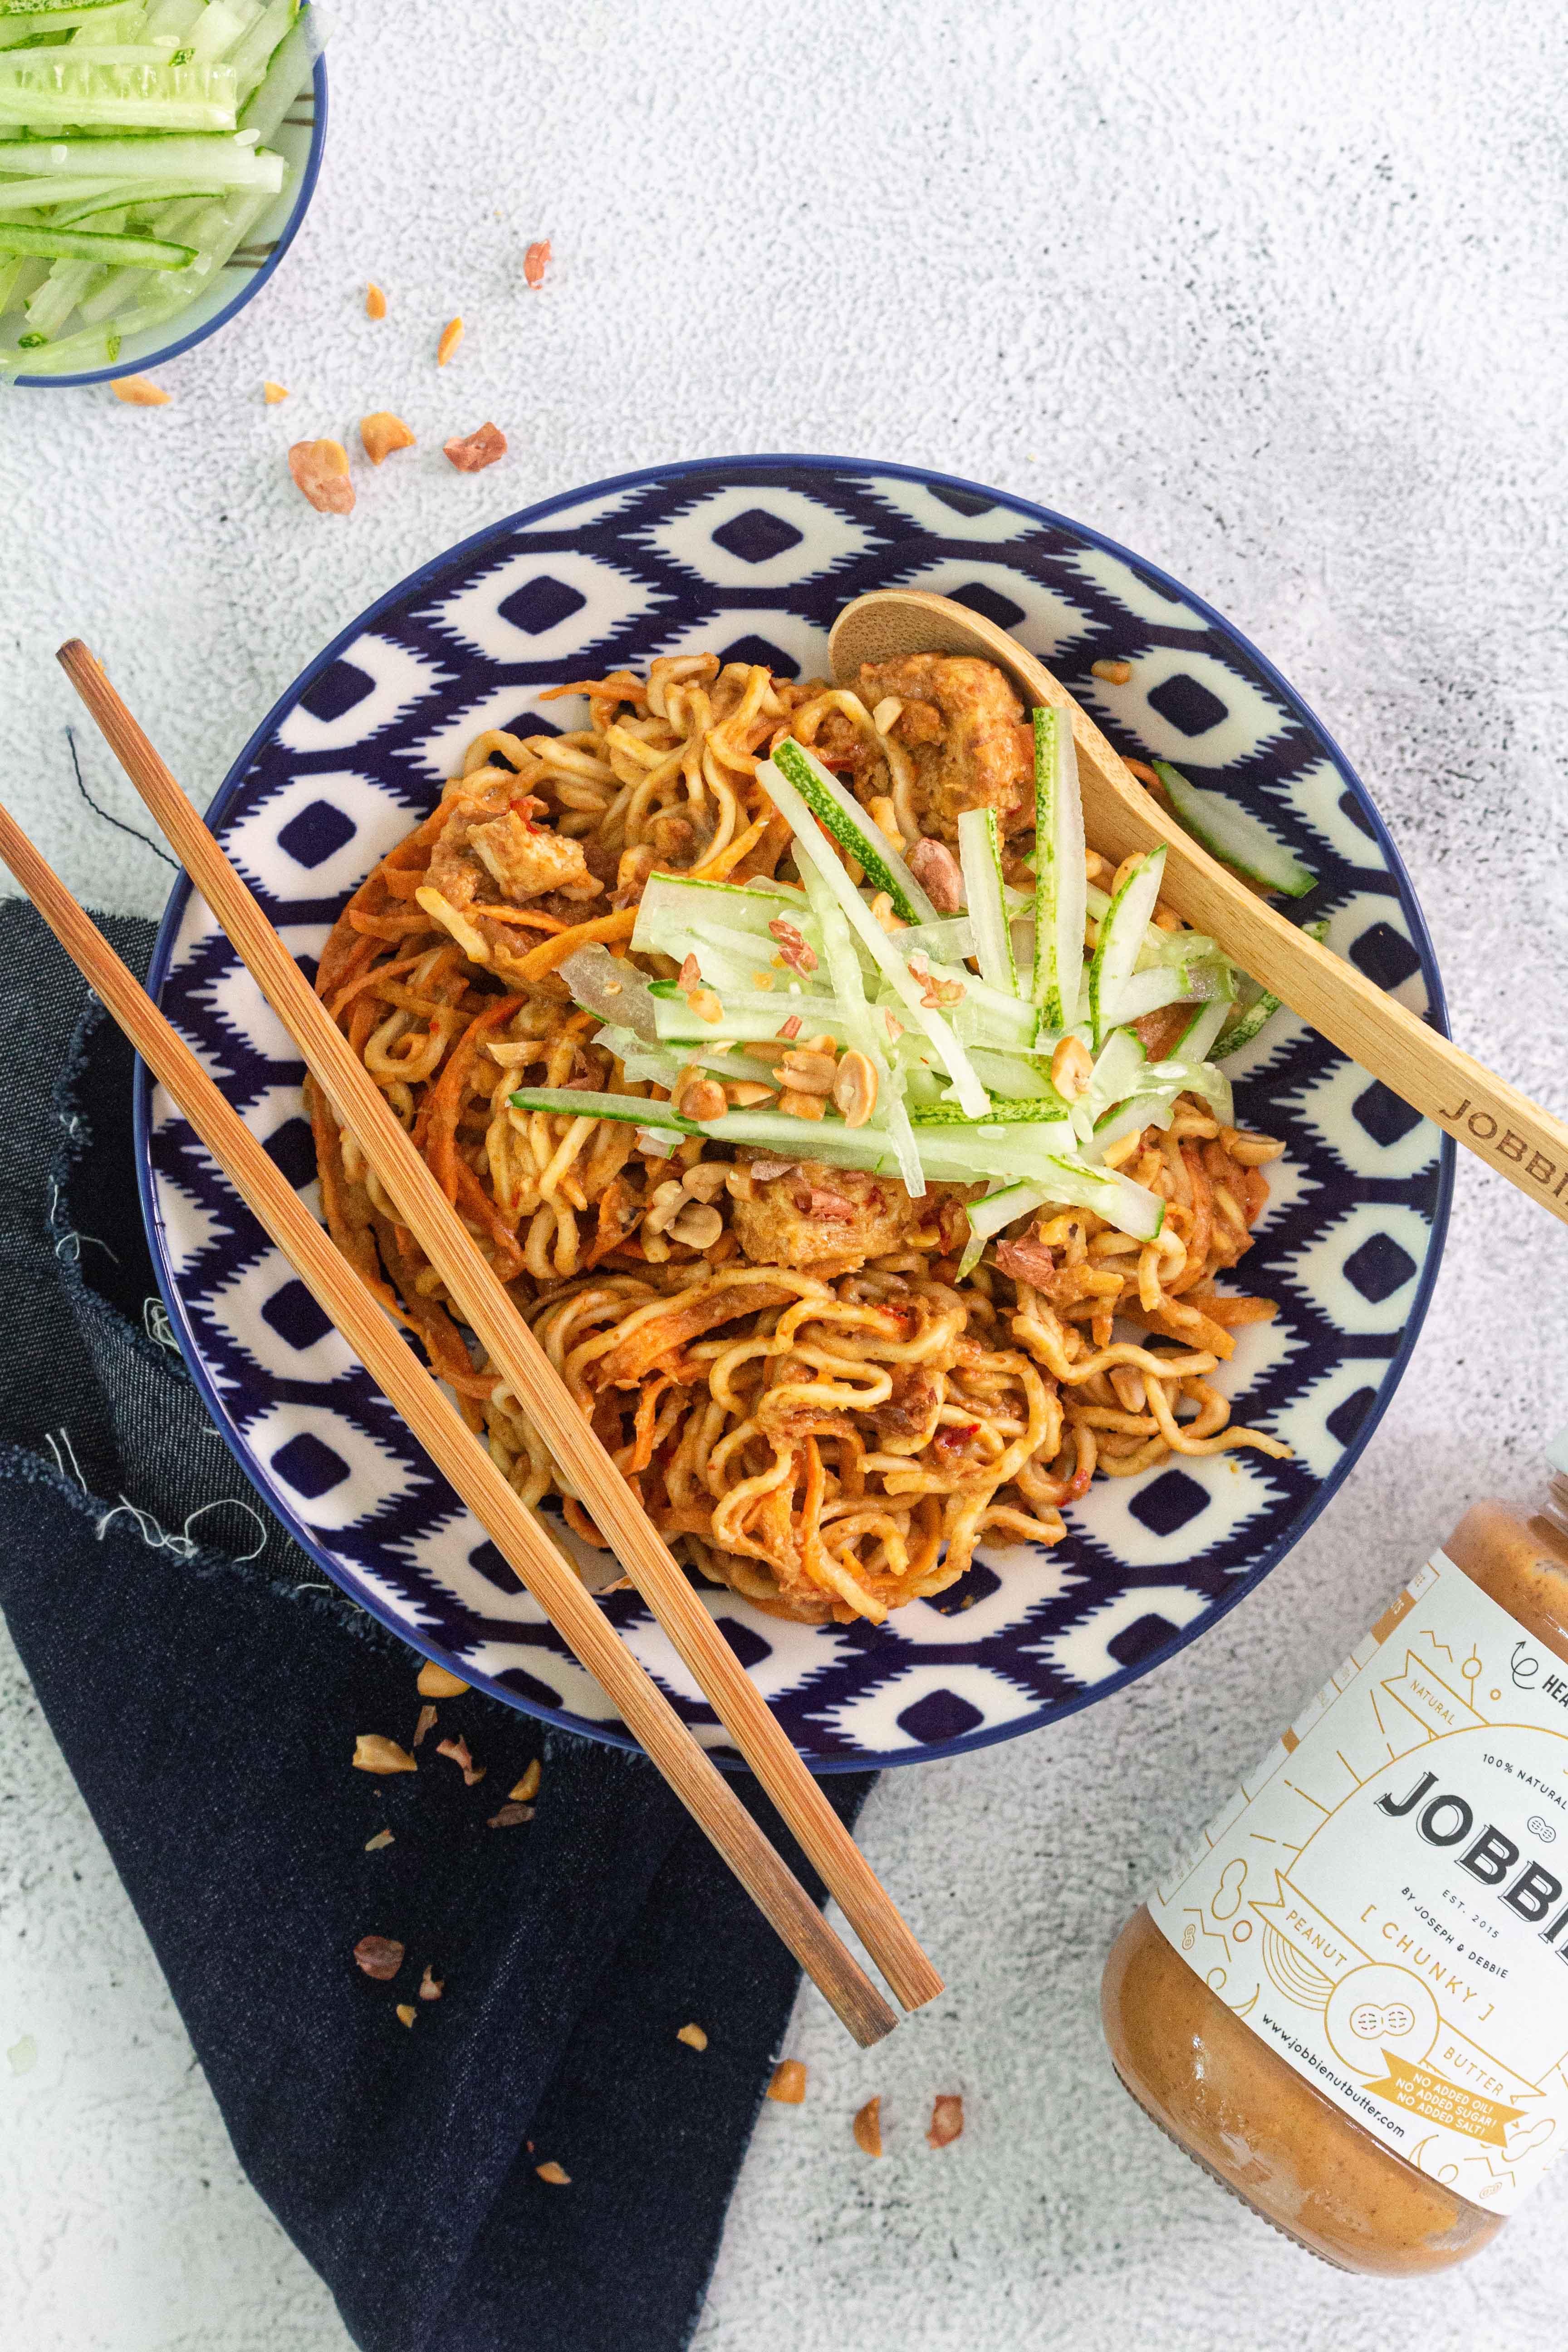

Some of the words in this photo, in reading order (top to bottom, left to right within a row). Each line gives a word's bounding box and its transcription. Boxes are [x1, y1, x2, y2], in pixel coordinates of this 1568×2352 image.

[1440, 1099, 1568, 1206] JOBBI
[1410, 1680, 1455, 1725] NATURAL
[1542, 1674, 1568, 1710] HEA
[1483, 1754, 1513, 1774] 100%
[1517, 1770, 1567, 1810] NATURAL
[1374, 1771, 1568, 1966] JOBBI
[1286, 1910, 1347, 1966] PEANUT
[1401, 1887, 1416, 1901] BY
[1414, 1906, 1455, 1944] JOSEPH
[1468, 1952, 1509, 1978] DEBBIE
[1442, 1889, 1466, 1913] EST.
[1472, 1915, 1499, 1938] 2015
[1382, 1922, 1477, 2002] CHUNKY
[1263, 2014, 1405, 2138] www.jobbienutbutter.com
[1413, 2073, 1431, 2087] NO
[1434, 2083, 1470, 2105] ADDED
[1472, 2100, 1494, 2114] OIL!
[1443, 2047, 1504, 2096] BUTTER
[1395, 2078, 1414, 2092] NO
[1416, 2089, 1453, 2111] ADDED
[1455, 2106, 1497, 2128] SUGAR!
[1396, 2092, 1415, 2106] NO
[1417, 2103, 1453, 2124] ADDED
[1455, 2119, 1486, 2136] SALT!
